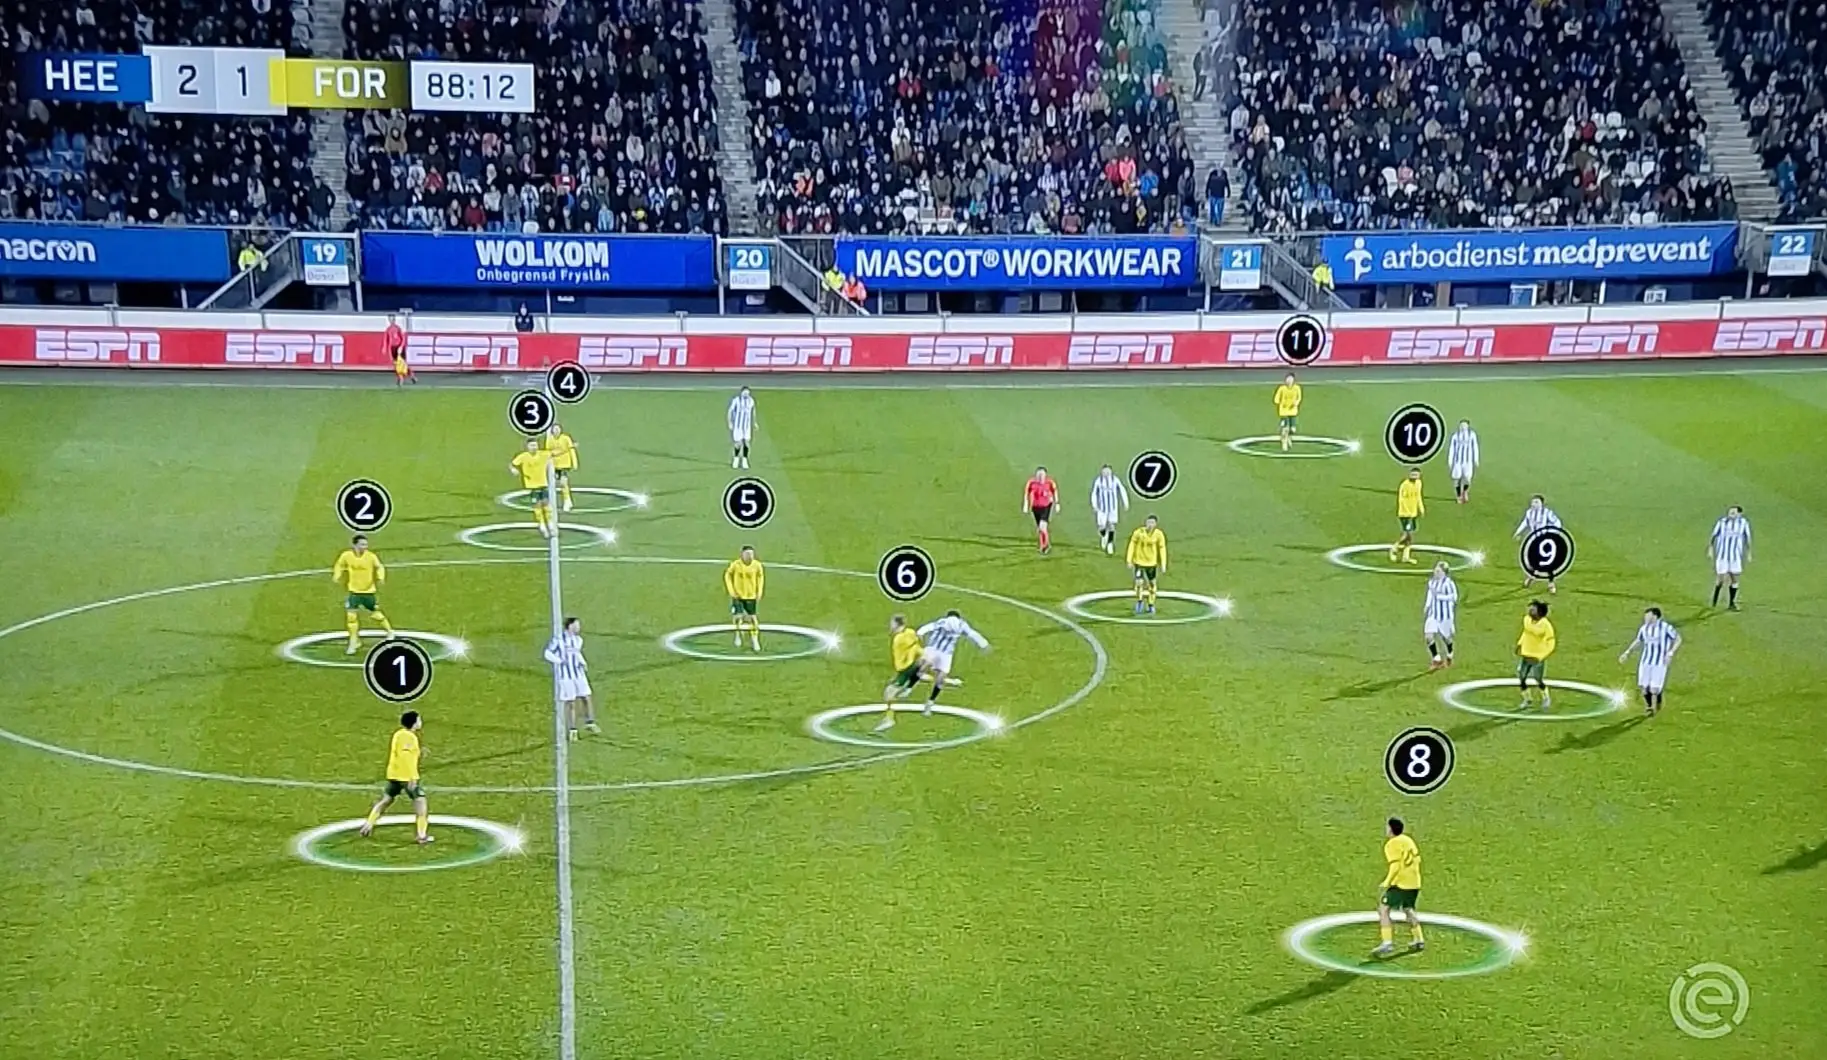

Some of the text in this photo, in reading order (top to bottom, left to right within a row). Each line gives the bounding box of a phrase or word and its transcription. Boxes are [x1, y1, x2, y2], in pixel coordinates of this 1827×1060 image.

[312, 243, 337, 262] 19
[475, 239, 609, 268] WOLKOM
[736, 249, 763, 268] 20
[1231, 249, 1252, 268] 21
[1382, 235, 1711, 270] arbodienst medprevent
[1779, 235, 1806, 254] 22
[476, 267, 556, 283] Onbegrensd
[1003, 248, 1181, 277] WORKWEAR
[35, 329, 161, 361] ESPN
[225, 333, 344, 363] ESPN
[1068, 334, 1174, 364] ESPN
[1387, 329, 1495, 358] ESPN
[1548, 324, 1659, 355] ESPN
[1713, 320, 1827, 351] ESPN
[406, 335, 519, 366] ESPN
[579, 336, 689, 367] ESPN
[745, 336, 852, 366] ESPN
[907, 336, 1014, 365] ESPN
